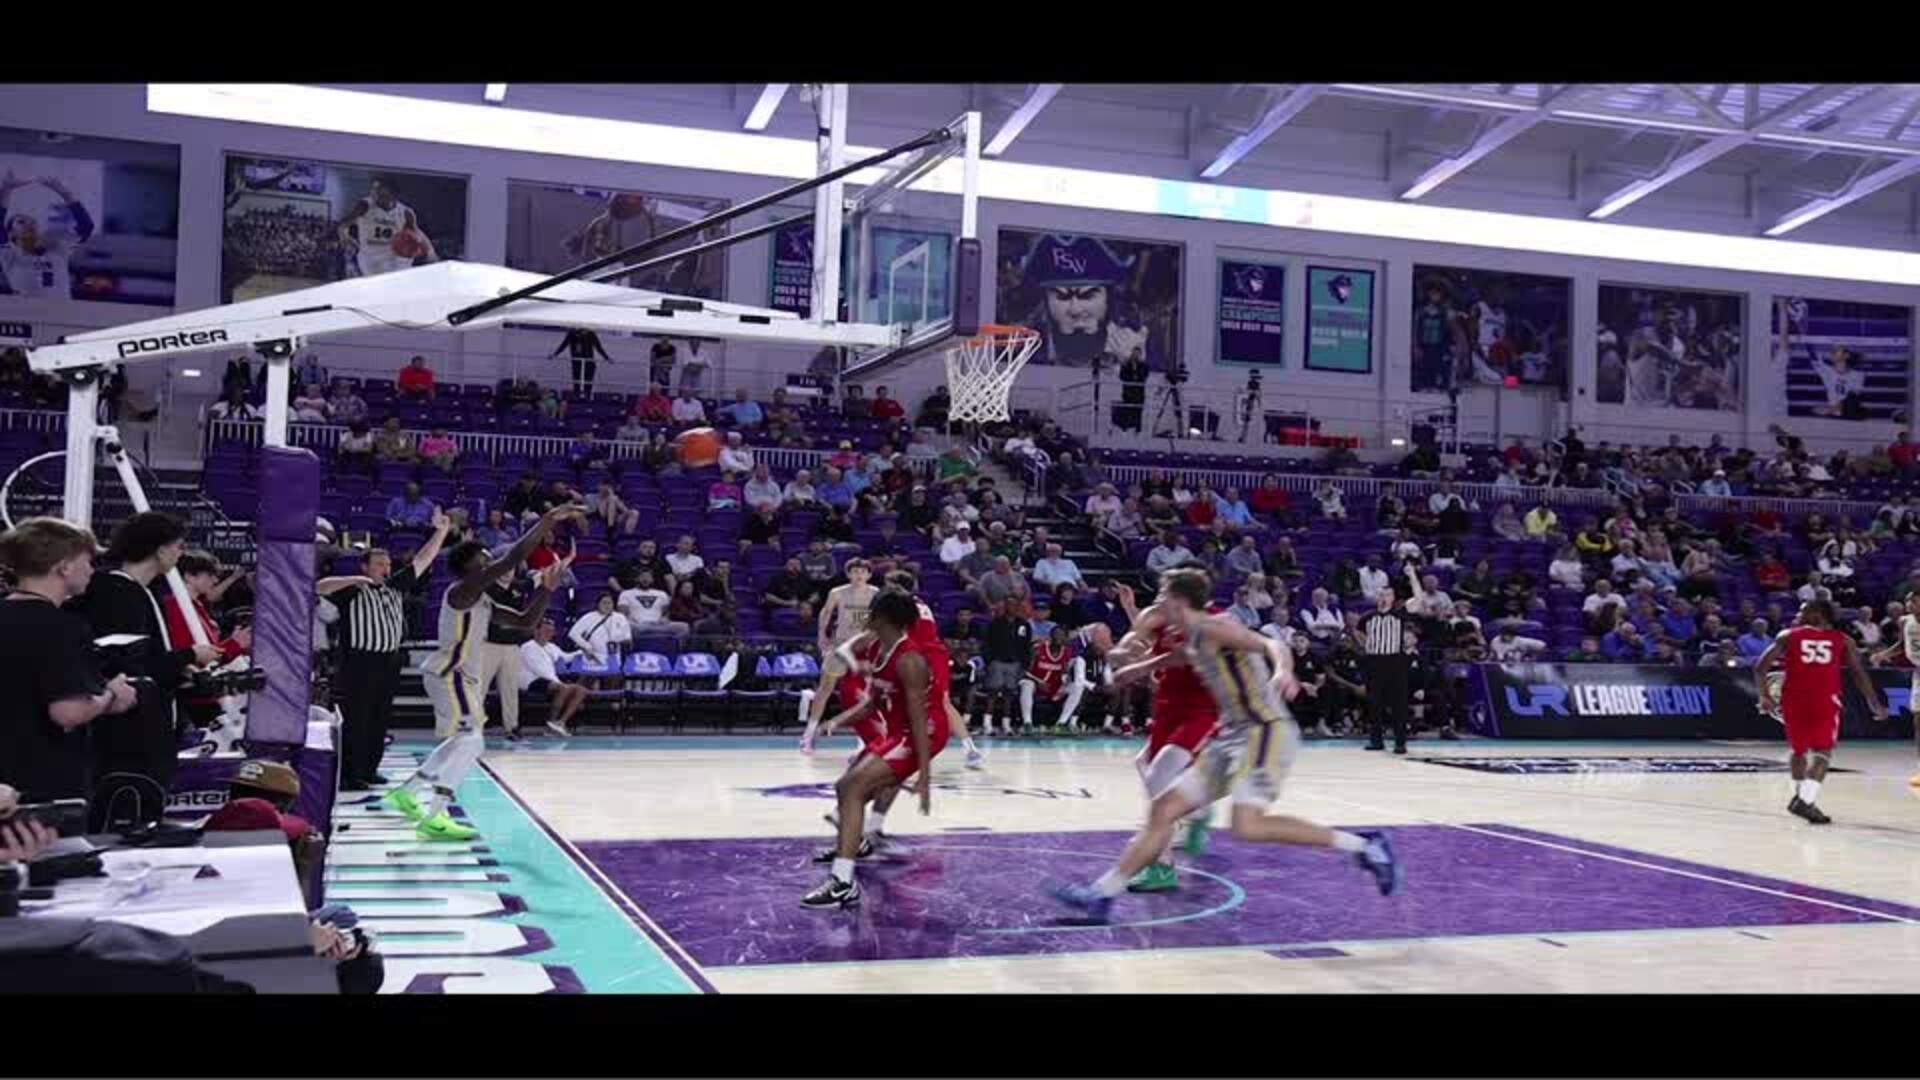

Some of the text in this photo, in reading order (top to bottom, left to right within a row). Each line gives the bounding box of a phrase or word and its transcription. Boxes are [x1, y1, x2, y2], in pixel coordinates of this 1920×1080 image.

[1052, 248, 1087, 273] FSW
[1801, 639, 1833, 664] 55
[1504, 685, 1569, 716] UR
